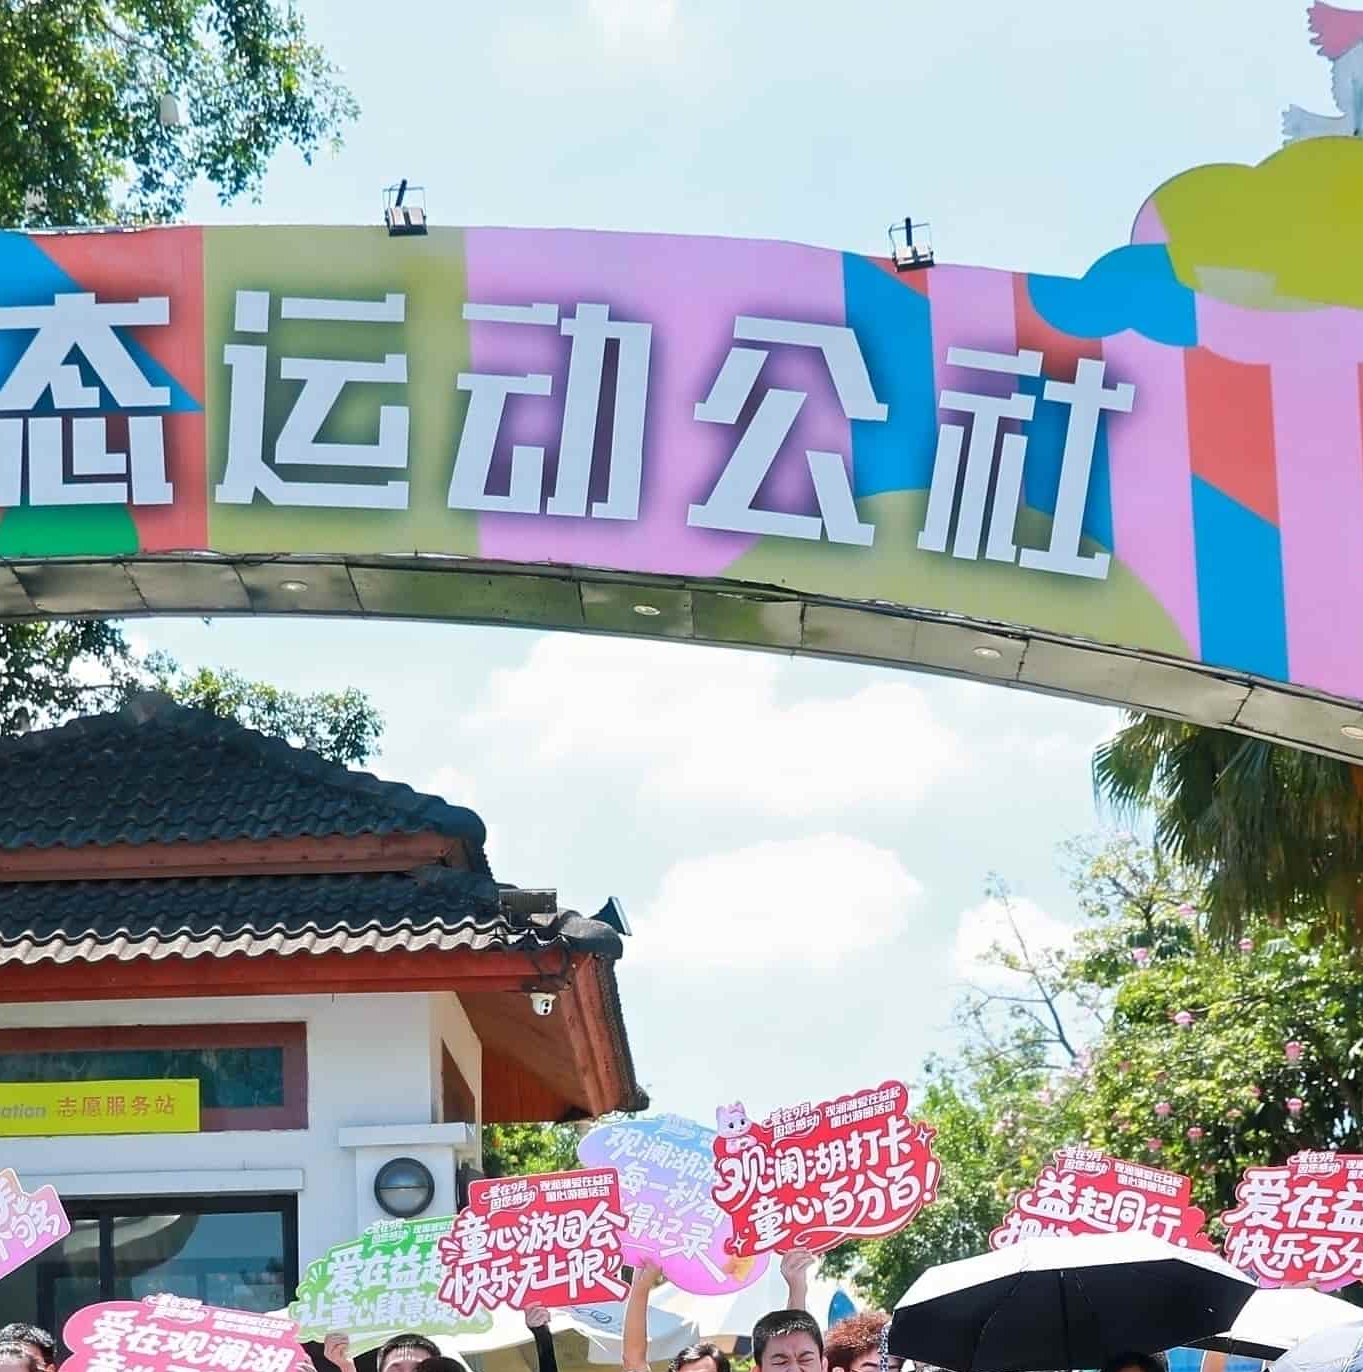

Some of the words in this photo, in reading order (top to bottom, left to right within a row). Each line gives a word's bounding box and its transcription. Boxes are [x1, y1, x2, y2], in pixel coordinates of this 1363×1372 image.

[56, 1094, 176, 1120] 志愿服务站
[715, 1115, 911, 1212] 观澜湖打卡
[455, 1201, 626, 1265] 童心游园会
[441, 1248, 627, 1314] 快乐无上限
